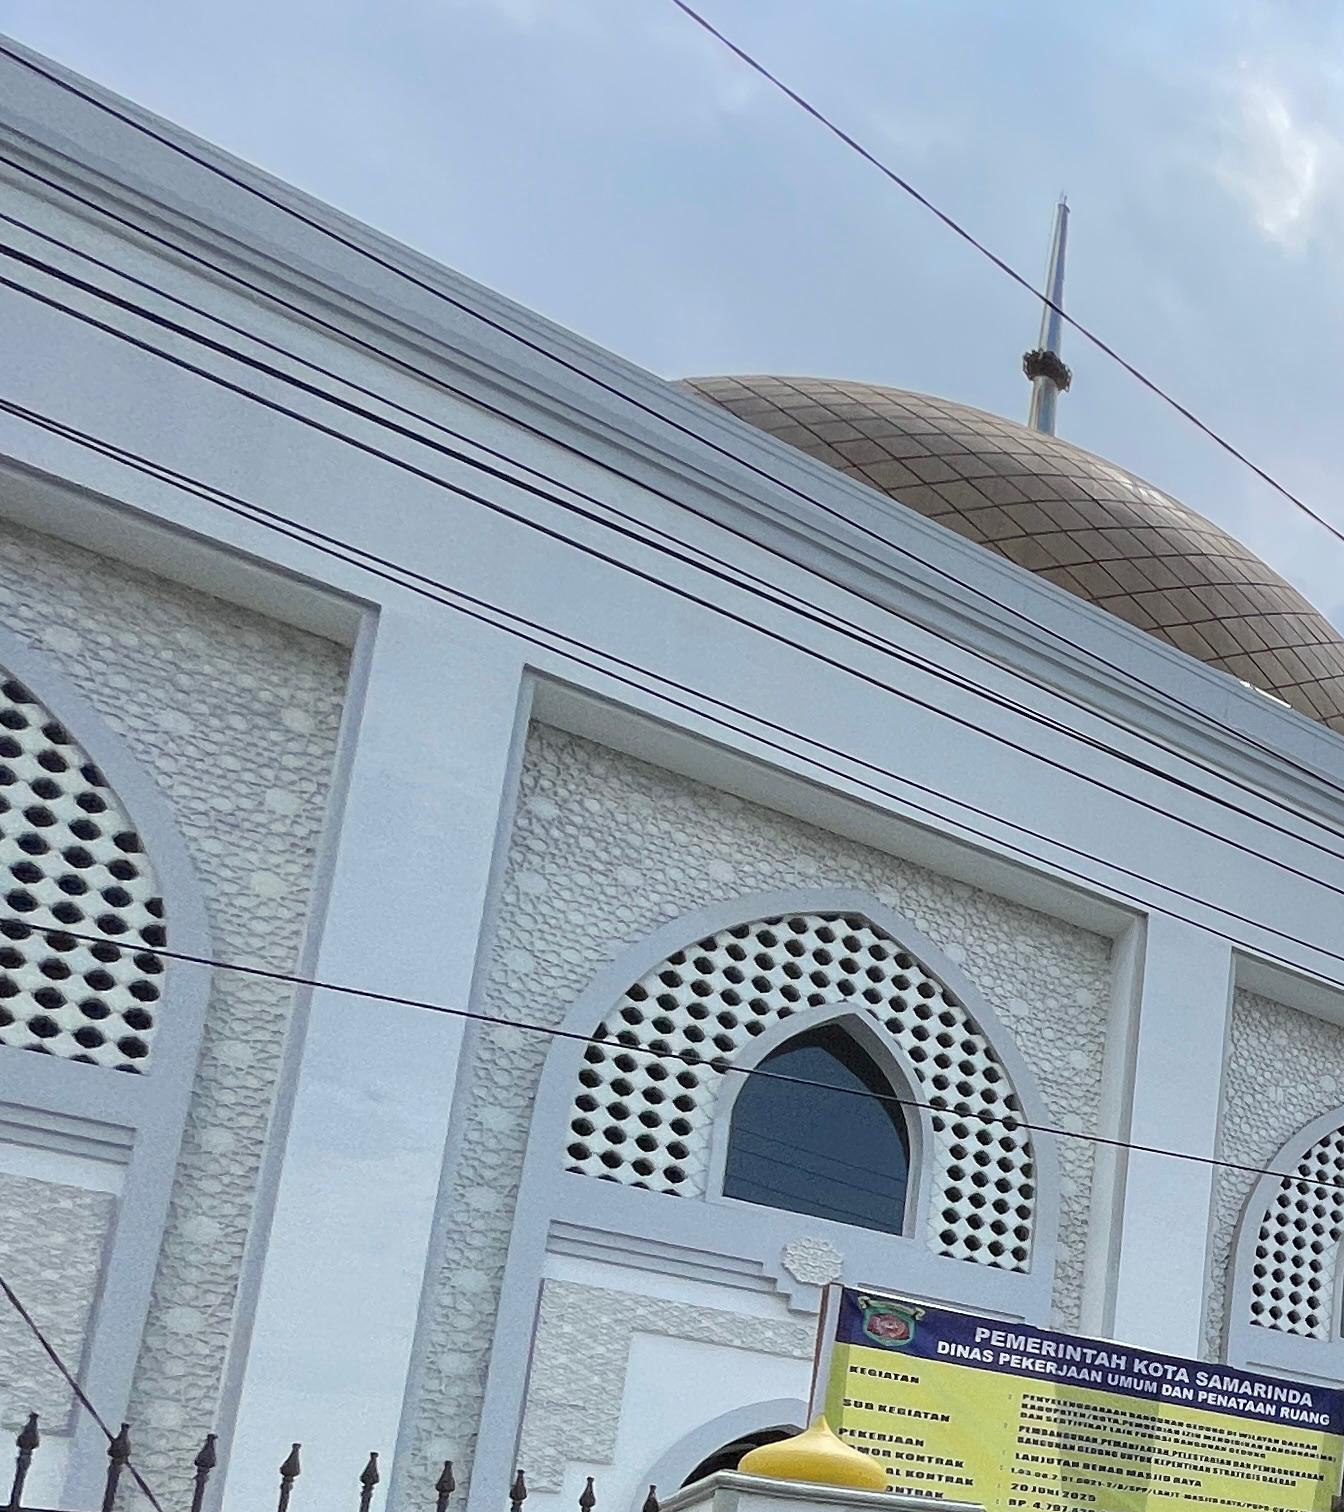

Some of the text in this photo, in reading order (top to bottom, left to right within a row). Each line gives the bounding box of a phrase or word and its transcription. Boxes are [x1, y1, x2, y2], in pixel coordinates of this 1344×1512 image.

[848, 1364, 920, 1385] KEGIATAN
[973, 1325, 1313, 1407] PEMERINTAH KOTA SAMARINDA
[936, 1339, 1330, 1427] DINAS PEKERJAAN UMUM DAN PENATAAN RUANG
[842, 1398, 950, 1423] SUB KEGIATAN
[837, 1426, 924, 1448] PEKERJAAN
[894, 1450, 964, 1469] KONTRAK
[1014, 1451, 1080, 1469] LANJUTAN
[904, 1468, 974, 1487] KONTRAK
[1010, 1482, 1096, 1502] 20 JUNI 2025
